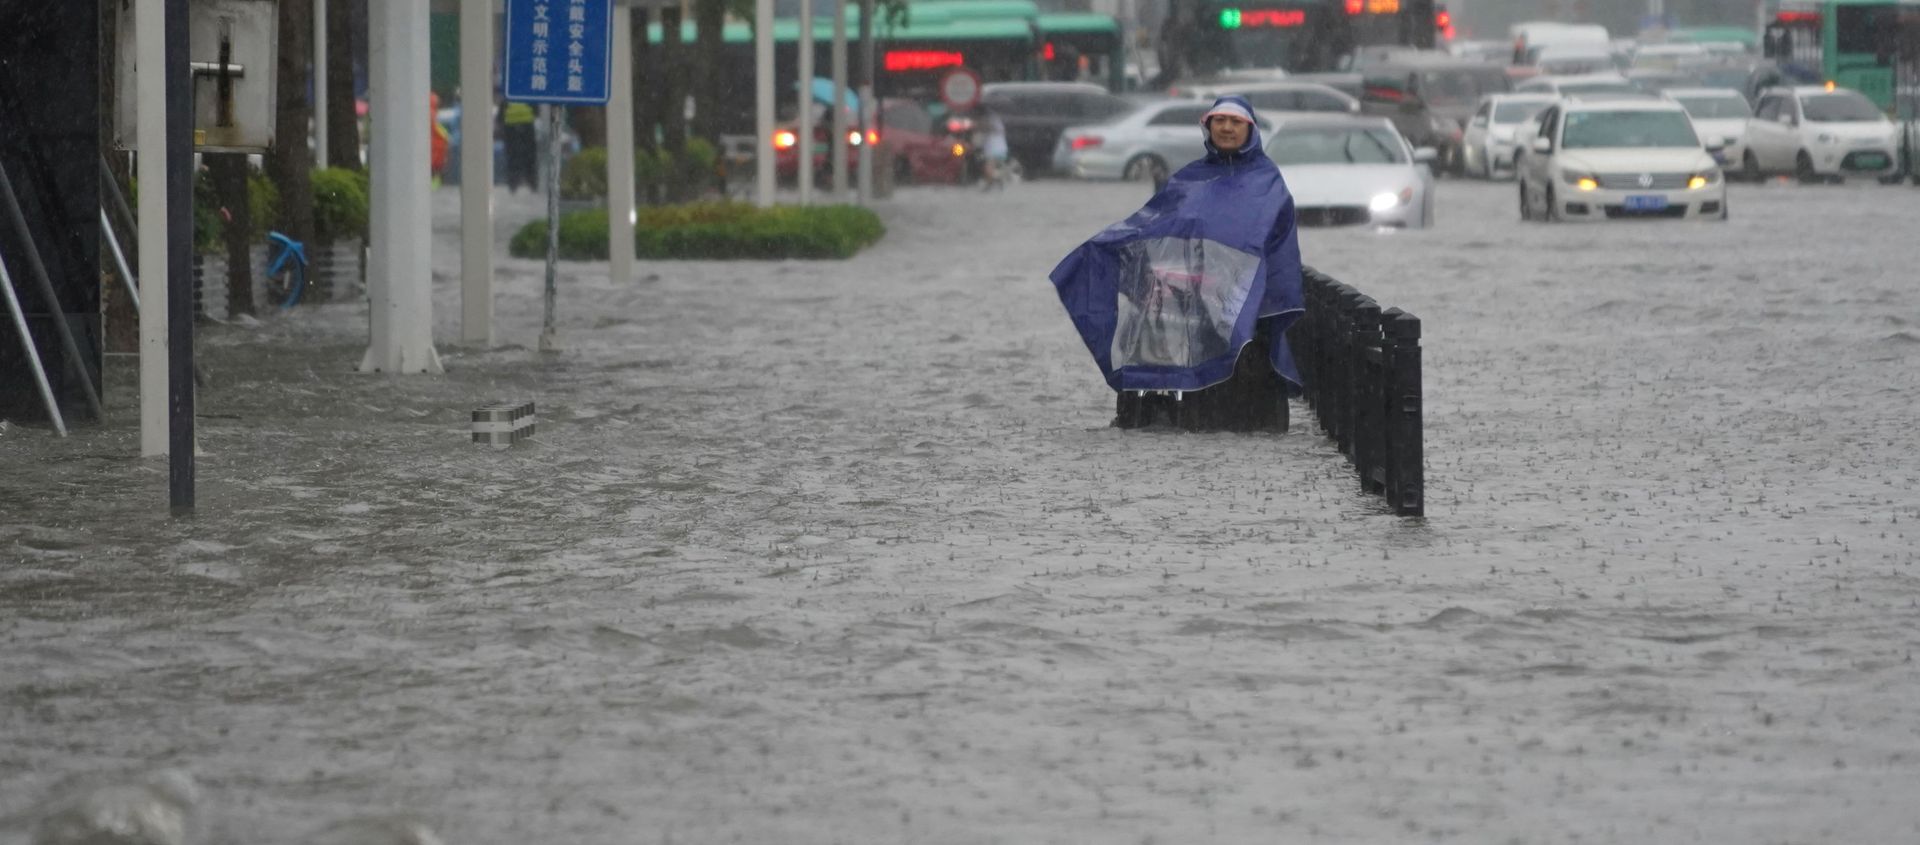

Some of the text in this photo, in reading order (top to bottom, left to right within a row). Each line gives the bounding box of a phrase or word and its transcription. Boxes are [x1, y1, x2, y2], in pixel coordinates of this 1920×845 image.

[531, 0, 549, 90] 文明示范路
[567, 0, 585, 91] 戴安全头盔
